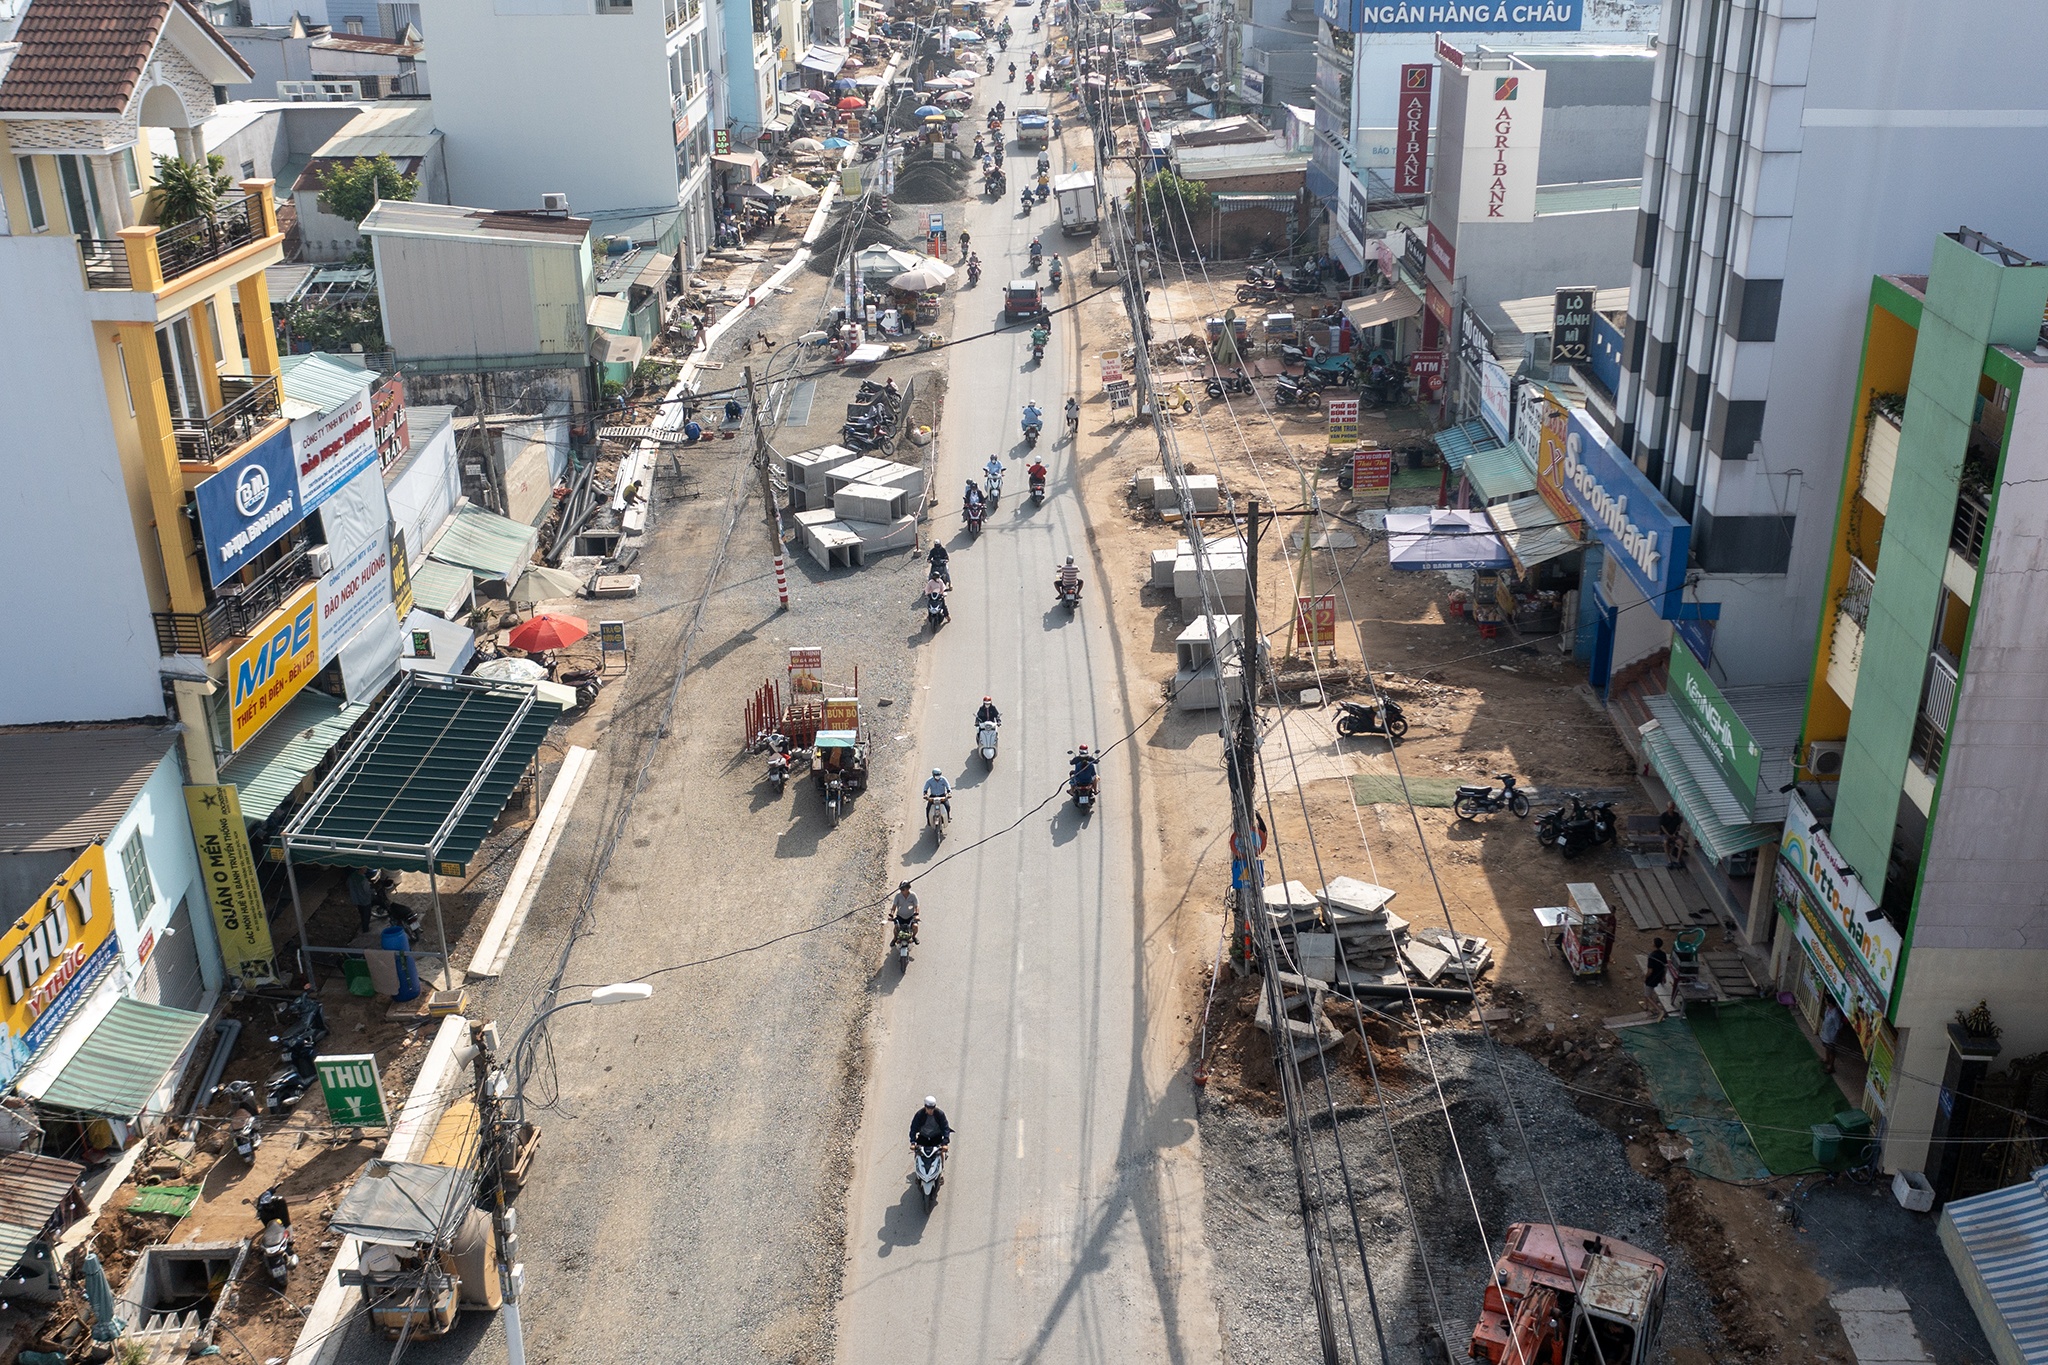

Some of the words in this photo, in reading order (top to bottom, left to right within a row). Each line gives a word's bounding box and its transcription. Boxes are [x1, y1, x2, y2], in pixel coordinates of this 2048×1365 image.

[1364, 2, 1424, 24] NGÂN
[1429, 2, 1490, 23] HÀNG
[1493, 1, 1508, 22] Á
[1512, 0, 1571, 22] CHÂU
[1403, 97, 1424, 187] AGRIBANK
[1488, 106, 1512, 217] AGRIBANK
[1566, 295, 1583, 309] LÒ
[1556, 312, 1590, 326] BÁNH
[1565, 328, 1579, 341] MÌ
[1554, 343, 1587, 360] X2
[1415, 362, 1438, 372] ATM
[318, 428, 325, 439] TY
[242, 474, 264, 502] BM
[1566, 432, 1661, 582] Sacombank
[324, 595, 339, 620] ĐÀO
[340, 576, 360, 605] NGỌC
[234, 602, 315, 710] MPE
[236, 700, 258, 730] THIẾT
[260, 693, 268, 709] BỊ
[268, 677, 284, 702] ĐIỆN
[288, 664, 302, 683] ĐÈN
[302, 650, 315, 671] LED
[827, 706, 844, 718] BÚN
[846, 706, 857, 718] BÒ
[200, 834, 225, 869] MẾN
[214, 871, 228, 883] O
[232, 870, 242, 888] BÁNH
[216, 887, 239, 930] QUÁN
[1809, 845, 1872, 959] Totto-chan
[2, 889, 69, 1005] THÚ
[69, 869, 93, 925] Y
[320, 1061, 373, 1088] THÚ
[344, 1096, 362, 1117] Y
